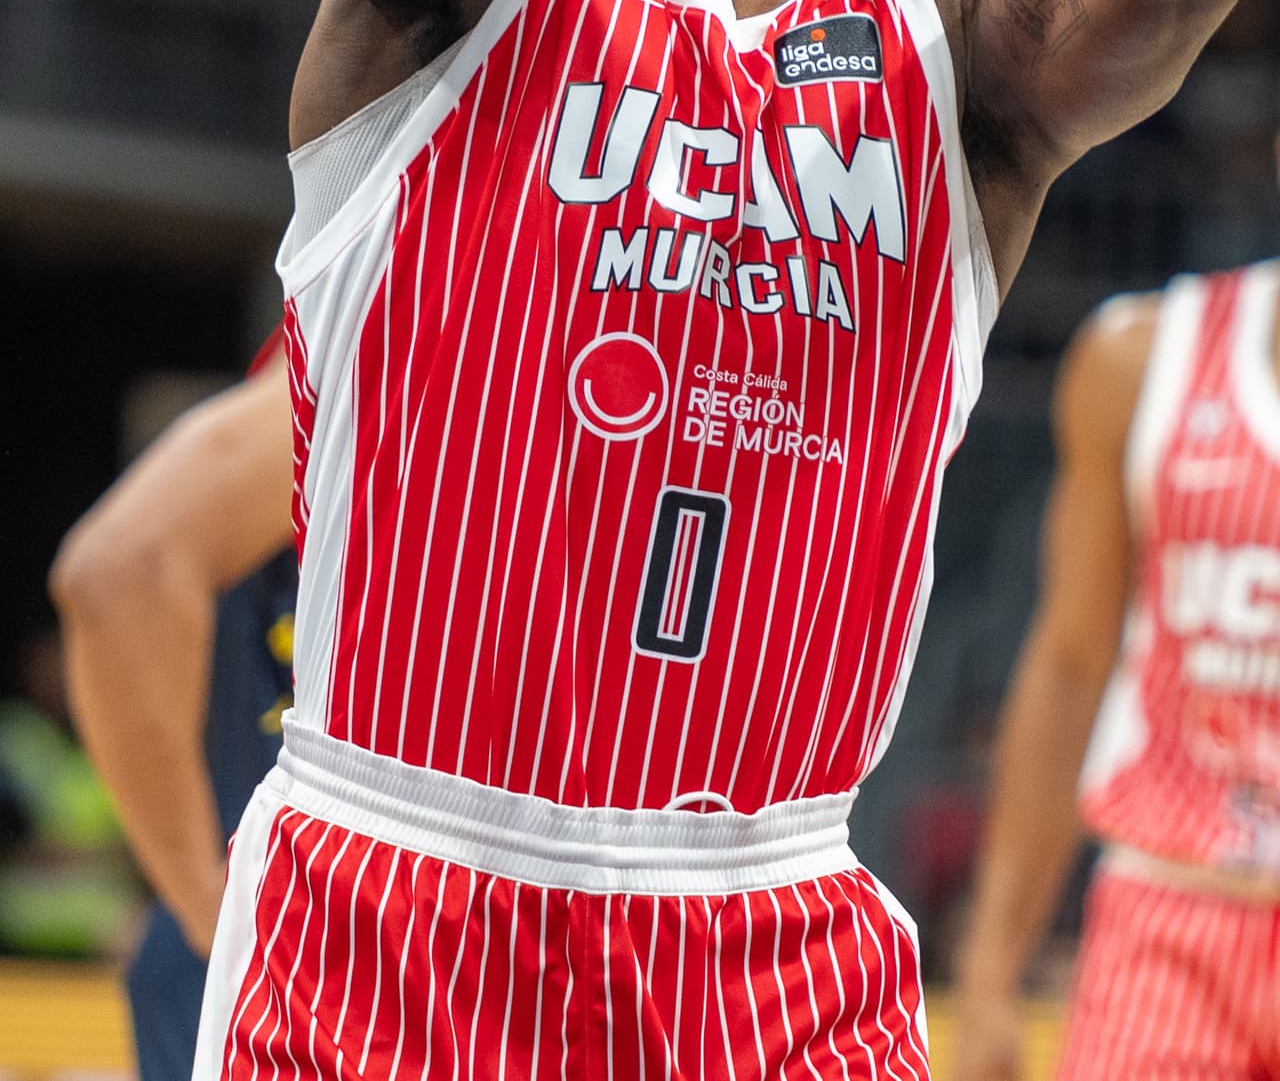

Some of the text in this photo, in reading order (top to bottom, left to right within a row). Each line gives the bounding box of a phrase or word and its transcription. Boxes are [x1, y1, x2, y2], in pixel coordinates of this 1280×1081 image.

[781, 41, 825, 63] liga
[785, 53, 877, 77] endesa
[546, 81, 906, 265] UCAM
[589, 226, 856, 334] MURCIA
[693, 364, 788, 391] Costa Cálida
[687, 386, 805, 428] REGIÓN
[682, 416, 844, 465] DE MURCIA
[631, 484, 732, 664] 0
